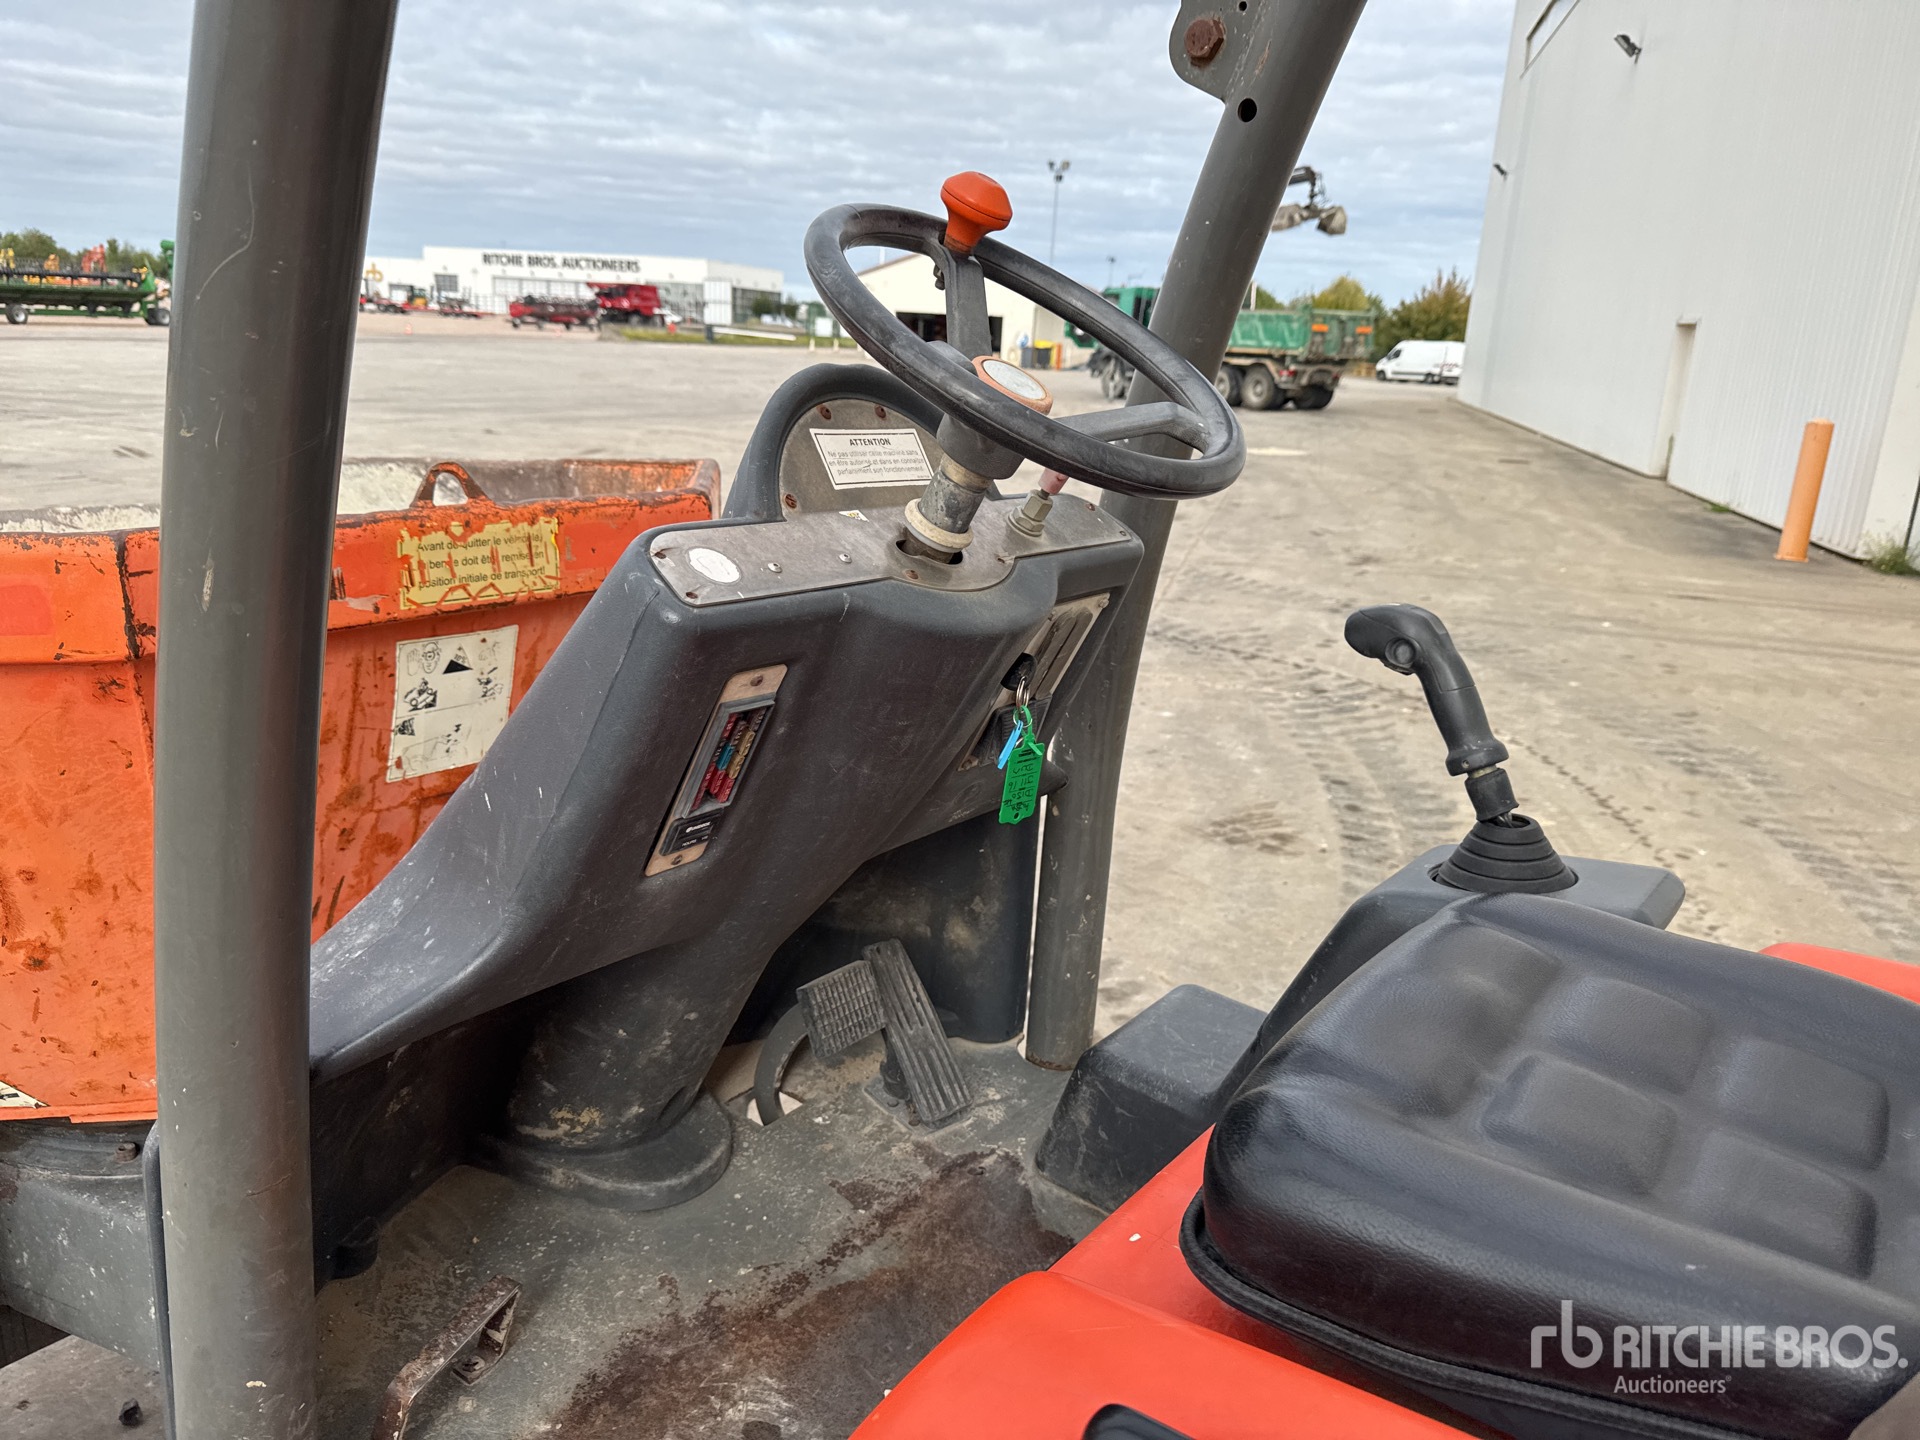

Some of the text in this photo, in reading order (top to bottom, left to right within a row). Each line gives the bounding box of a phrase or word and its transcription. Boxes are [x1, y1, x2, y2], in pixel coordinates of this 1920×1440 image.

[483, 252, 523, 266] RITCHIE
[562, 256, 640, 273] AUCTIONEERS
[849, 438, 891, 446] ATTENTION
[417, 541, 445, 553] Avant
[463, 537, 491, 551] quitter
[493, 535, 502, 546] le
[429, 559, 459, 570] bene
[461, 556, 479, 566] doit
[534, 550, 544, 558] en
[458, 571, 489, 584] initiale
